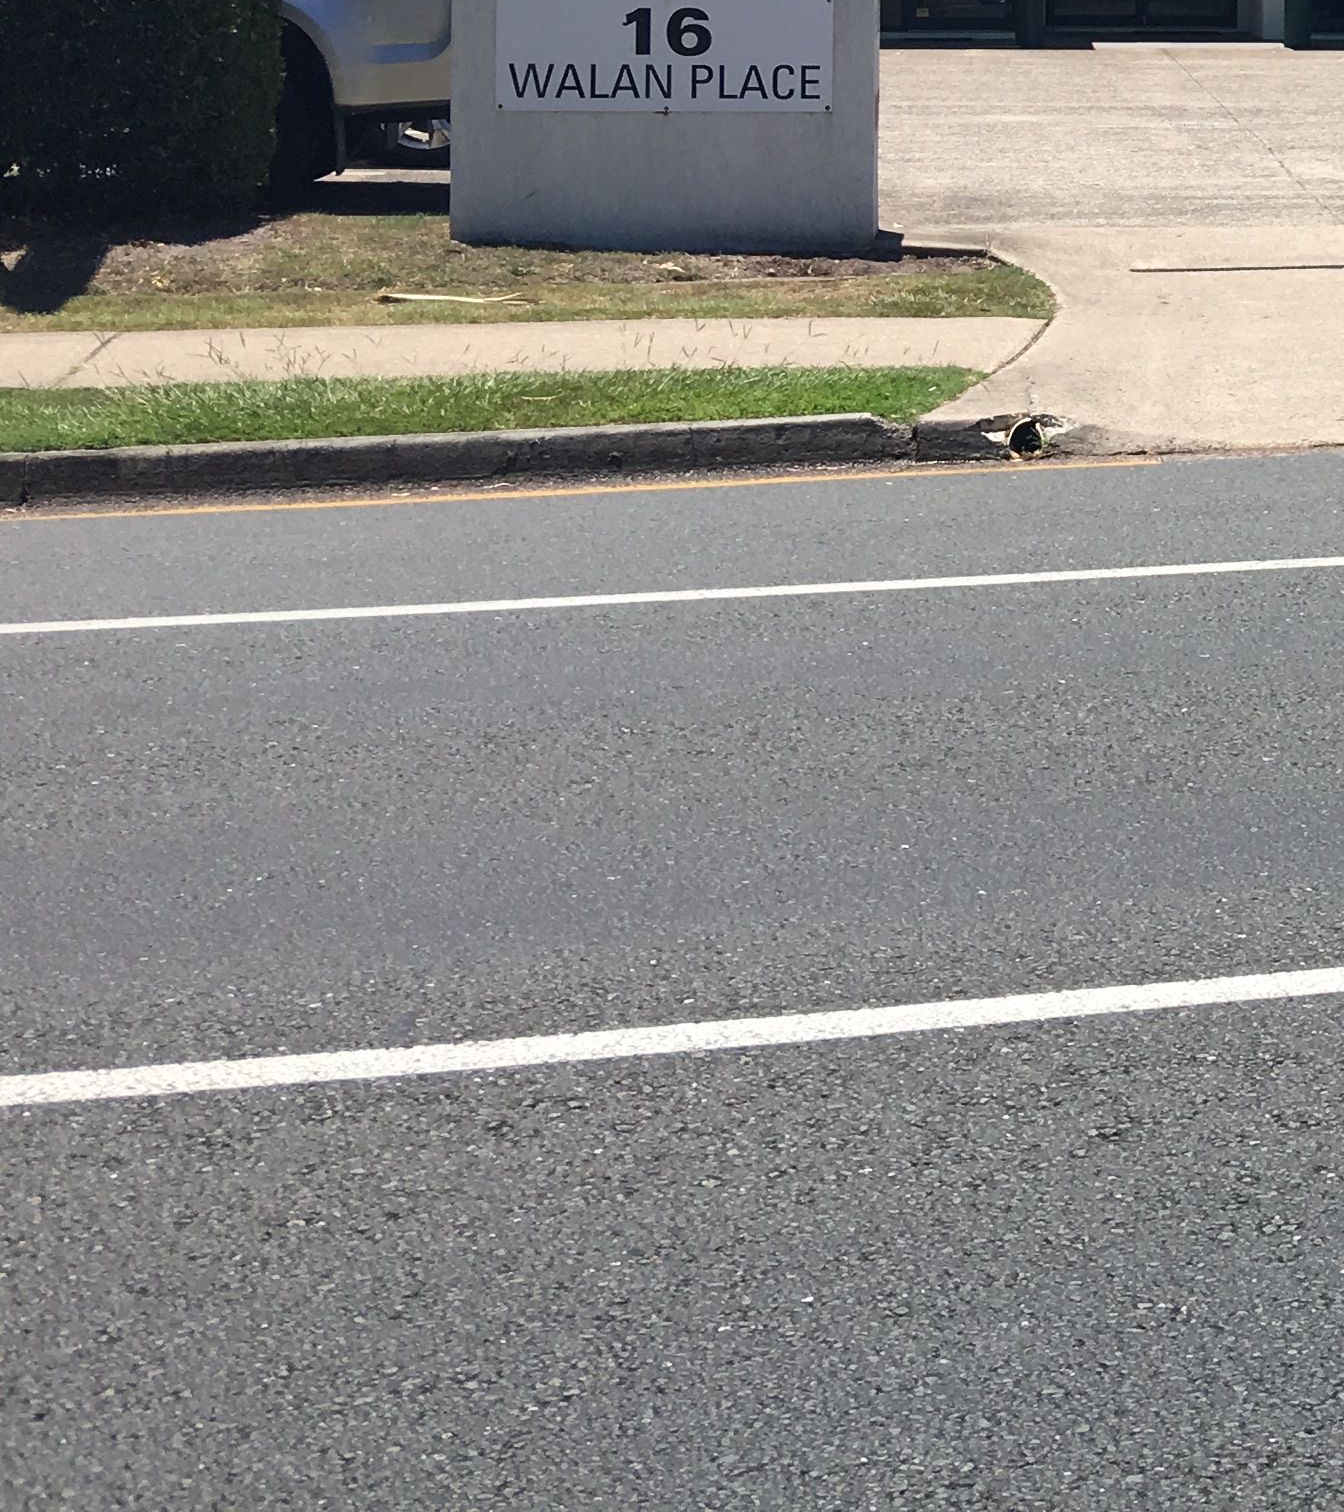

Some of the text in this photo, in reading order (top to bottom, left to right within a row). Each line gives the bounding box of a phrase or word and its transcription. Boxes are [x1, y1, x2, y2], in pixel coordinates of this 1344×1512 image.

[622, 7, 713, 57] 16
[508, 63, 821, 100] WALAN PLACE
